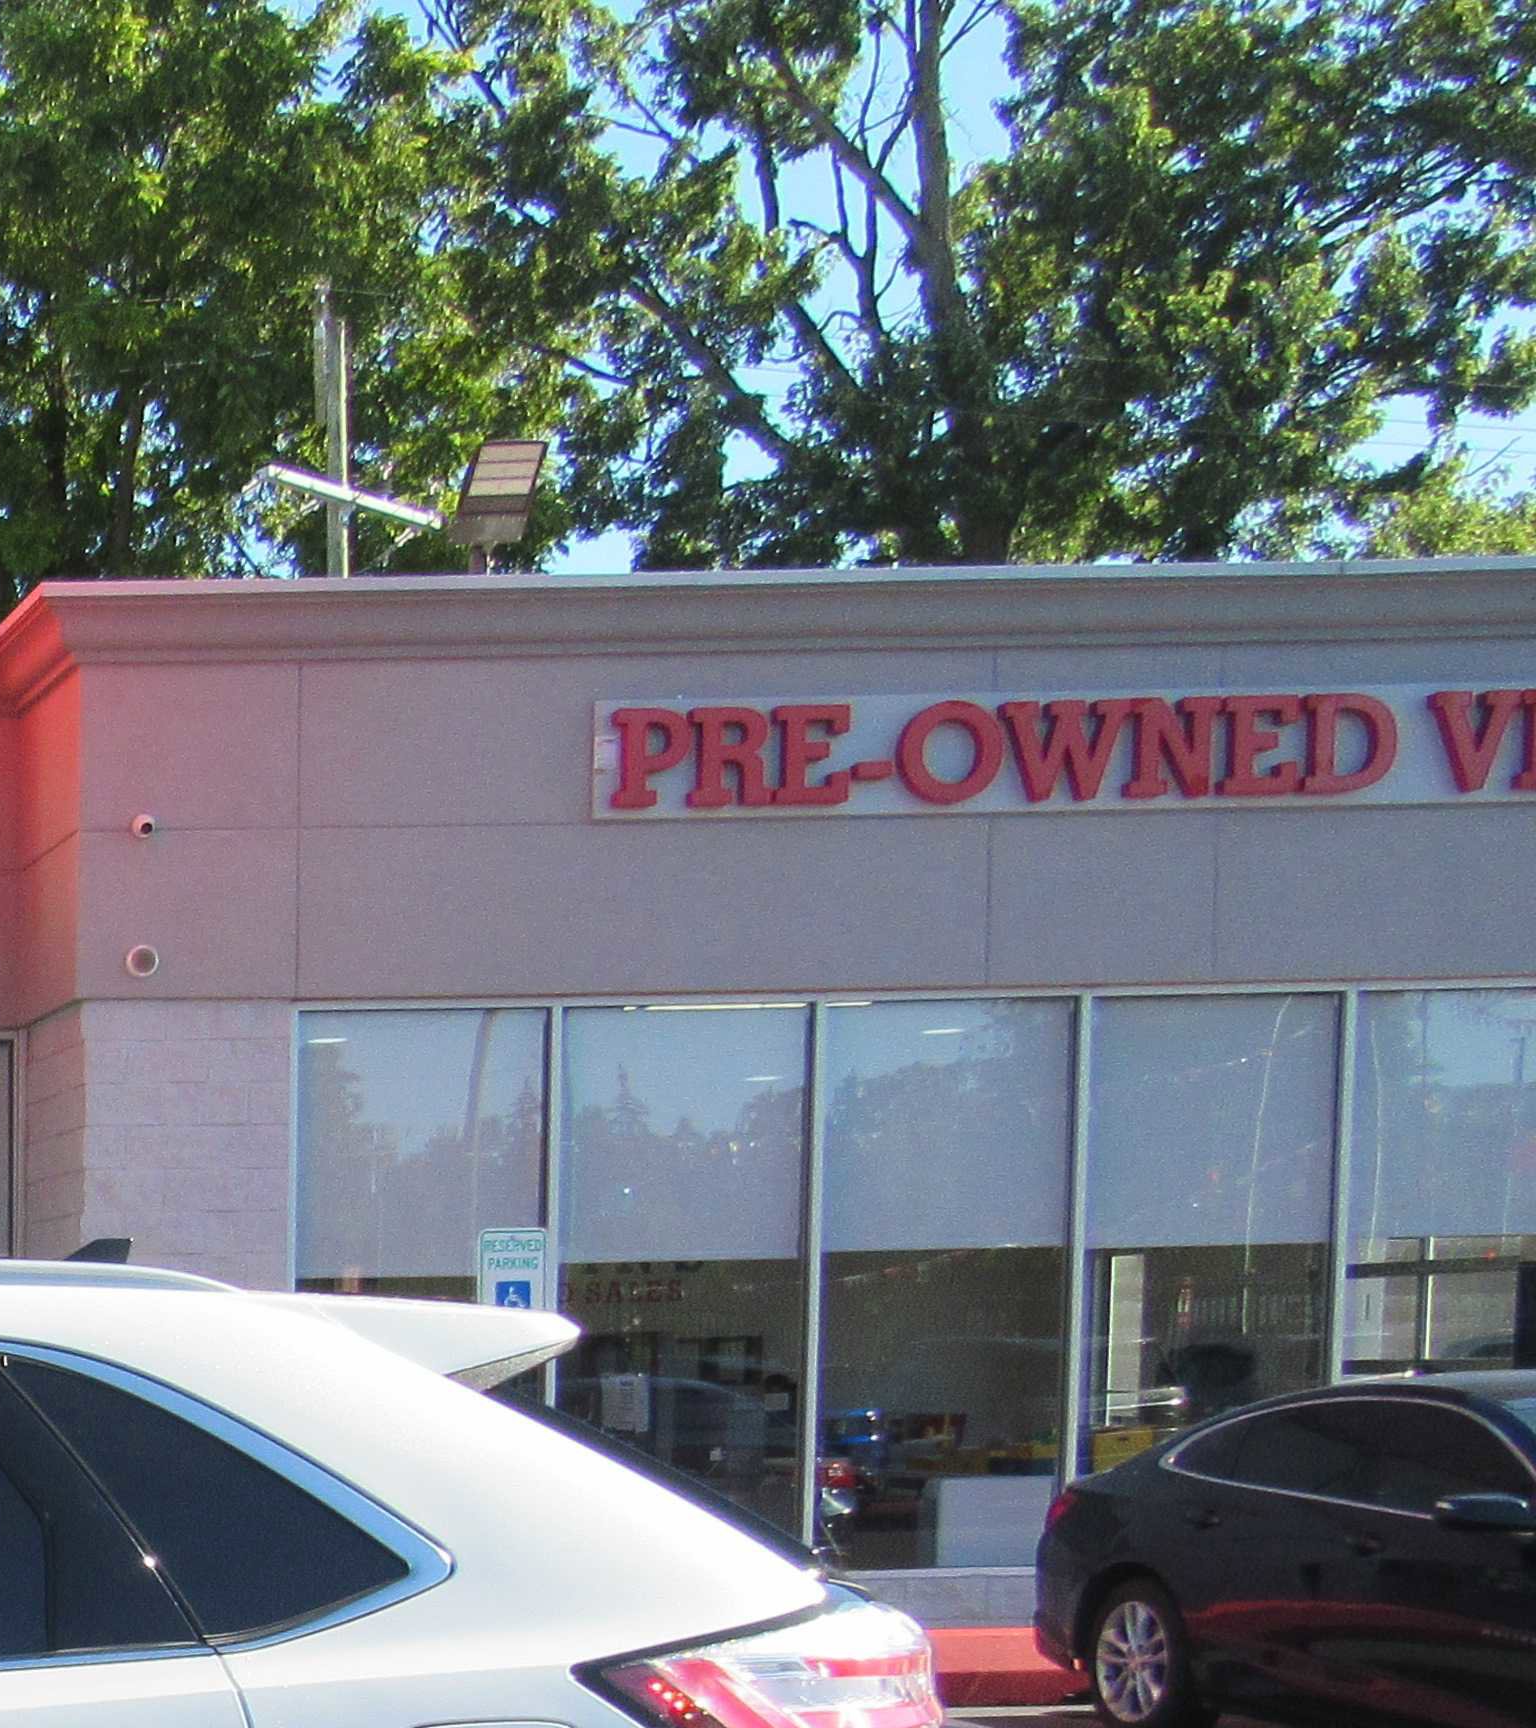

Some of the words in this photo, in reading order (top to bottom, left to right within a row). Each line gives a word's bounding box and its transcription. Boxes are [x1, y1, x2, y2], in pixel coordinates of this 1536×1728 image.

[611, 692, 1398, 808] PRE-OWNED
[483, 1239, 544, 1253] RESERVED
[488, 1256, 539, 1271] PARKING
